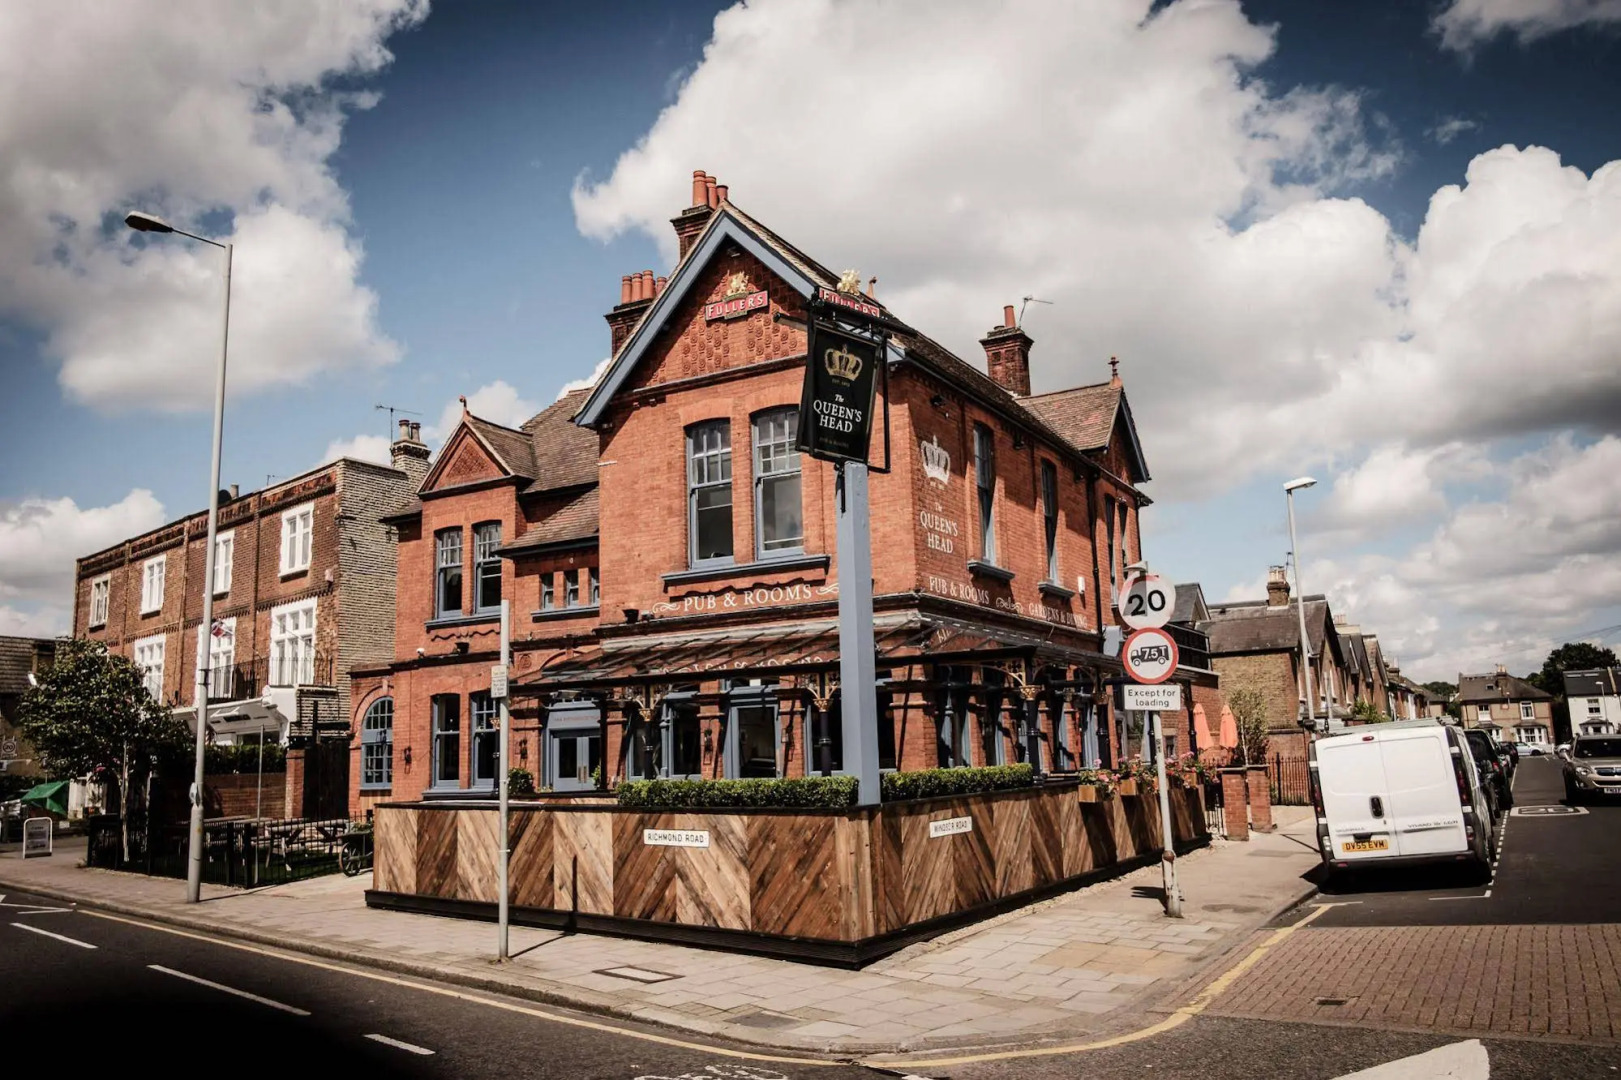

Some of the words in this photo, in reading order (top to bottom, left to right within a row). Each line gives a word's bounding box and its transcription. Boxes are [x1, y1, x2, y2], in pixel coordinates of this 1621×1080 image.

[835, 394, 844, 402] The
[813, 399, 862, 422] QUEEN'S
[819, 415, 853, 432] HEAD
[920, 509, 958, 537] QUEEN'S
[927, 532, 953, 553] HEAD
[683, 595, 716, 611] PUB
[723, 592, 737, 607] &
[743, 584, 812, 604] ROOMS
[929, 576, 948, 594] PUB
[950, 581, 957, 597] &
[959, 583, 990, 605] ROOMS
[1028, 602, 1060, 622] GARDENS
[1060, 611, 1066, 624] &
[1127, 589, 1166, 617] 20
[1128, 689, 1160, 697] Except
[1162, 689, 1176, 697] for
[1135, 699, 1170, 708] loading
[647, 832, 683, 842] RICHMOND
[685, 834, 704, 843] ROAD
